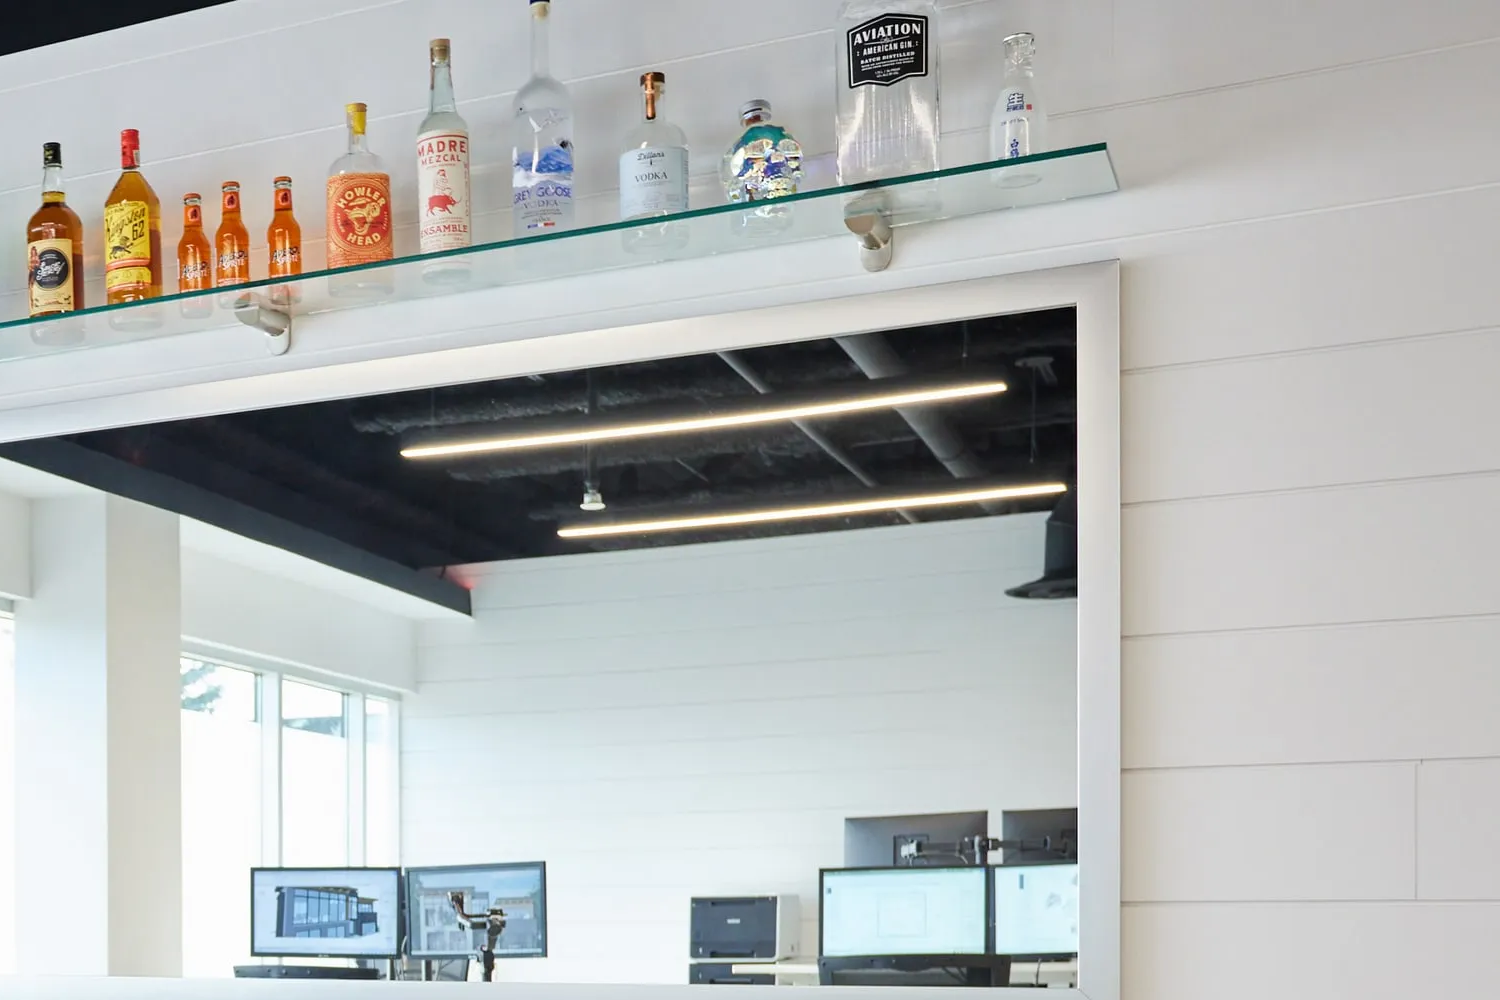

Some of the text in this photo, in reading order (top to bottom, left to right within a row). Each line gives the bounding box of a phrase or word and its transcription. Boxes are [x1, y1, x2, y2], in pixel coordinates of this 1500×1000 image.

[853, 22, 921, 46] AVIATION
[862, 40, 912, 57] AMERICAN GIN
[860, 56, 881, 65] BATCH
[882, 51, 915, 60] DISTILLED
[417, 139, 467, 159] MADRE
[420, 153, 462, 166] MEZCAL
[634, 171, 669, 182] VODKA
[336, 186, 387, 209] HOWLER
[535, 184, 572, 199] GOOSE
[131, 219, 145, 241] 62
[346, 232, 382, 246] HEAD
